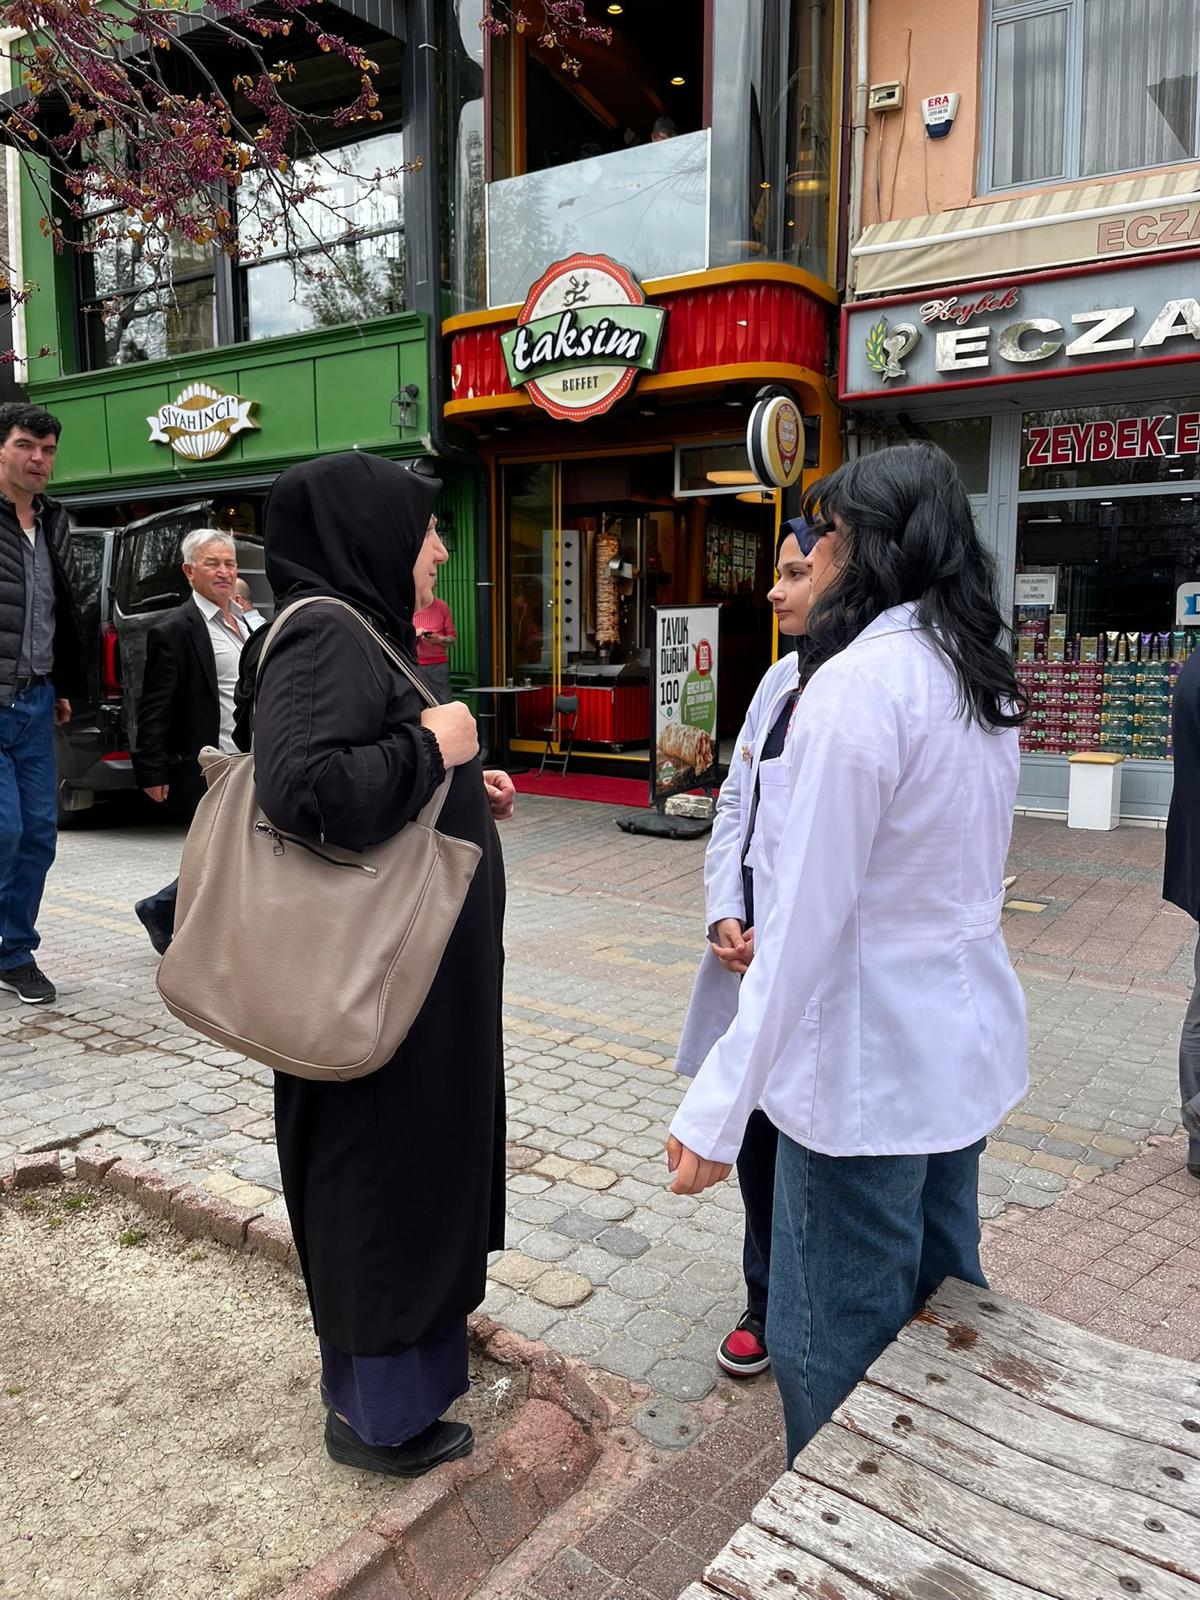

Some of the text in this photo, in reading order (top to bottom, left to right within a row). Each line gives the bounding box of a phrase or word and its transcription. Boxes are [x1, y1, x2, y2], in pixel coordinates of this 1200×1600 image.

[928, 95, 949, 107] ERA
[1097, 209, 1200, 254] ECZ
[920, 287, 1019, 325] Zeybek
[513, 310, 643, 371] taksim
[936, 298, 1200, 372] ECZA
[562, 375, 599, 392] BUFFET
[1027, 416, 1166, 466] ZEYBEK
[661, 616, 689, 647] TAVUK
[661, 646, 689, 675] DÜRÜM
[660, 679, 679, 706] 100
